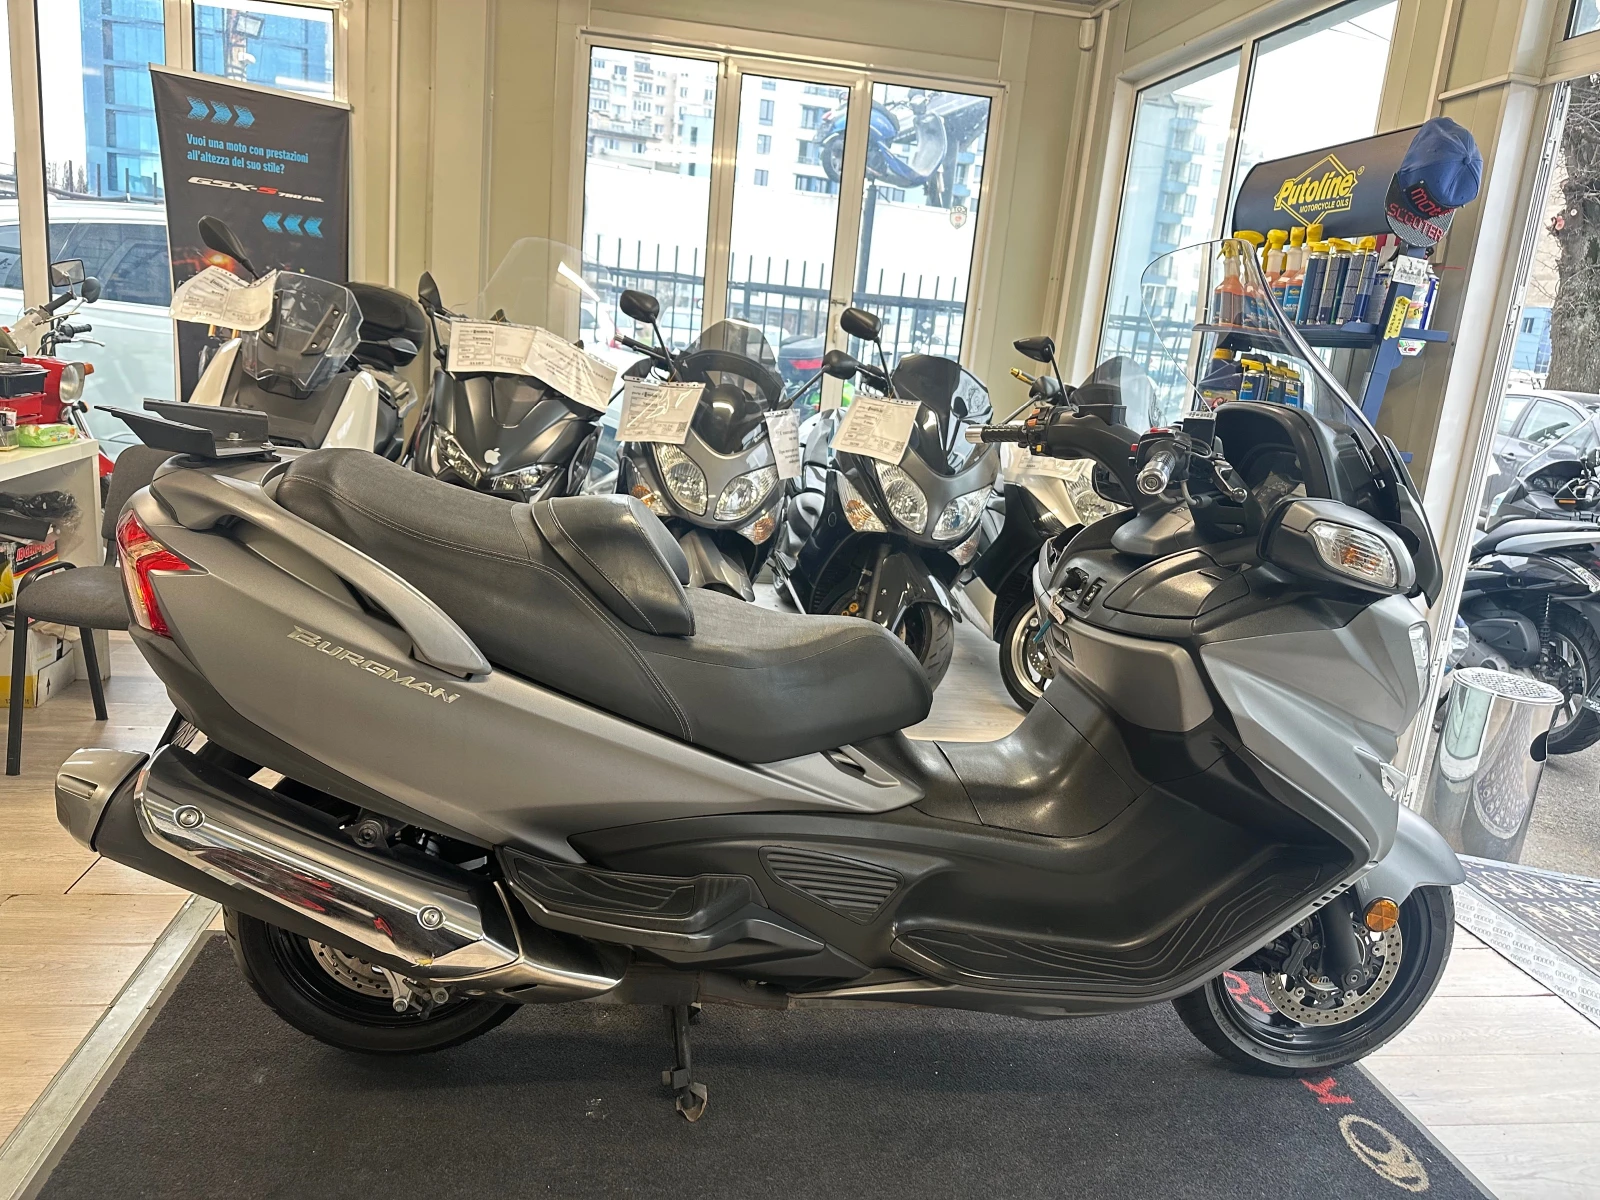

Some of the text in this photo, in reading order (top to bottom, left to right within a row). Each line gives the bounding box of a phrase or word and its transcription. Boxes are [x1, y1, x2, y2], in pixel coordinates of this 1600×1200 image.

[186, 133, 309, 163] Vuoi una moto con prestazioni
[187, 150, 285, 174] all'altezza del suo stile?
[187, 176, 278, 195] GSX-S
[1276, 171, 1354, 208] Putoline
[1299, 199, 1349, 213] MOTORCYCLE OILS
[1387, 202, 1444, 242] SCOOTER
[287, 624, 461, 703] BURGMAN
